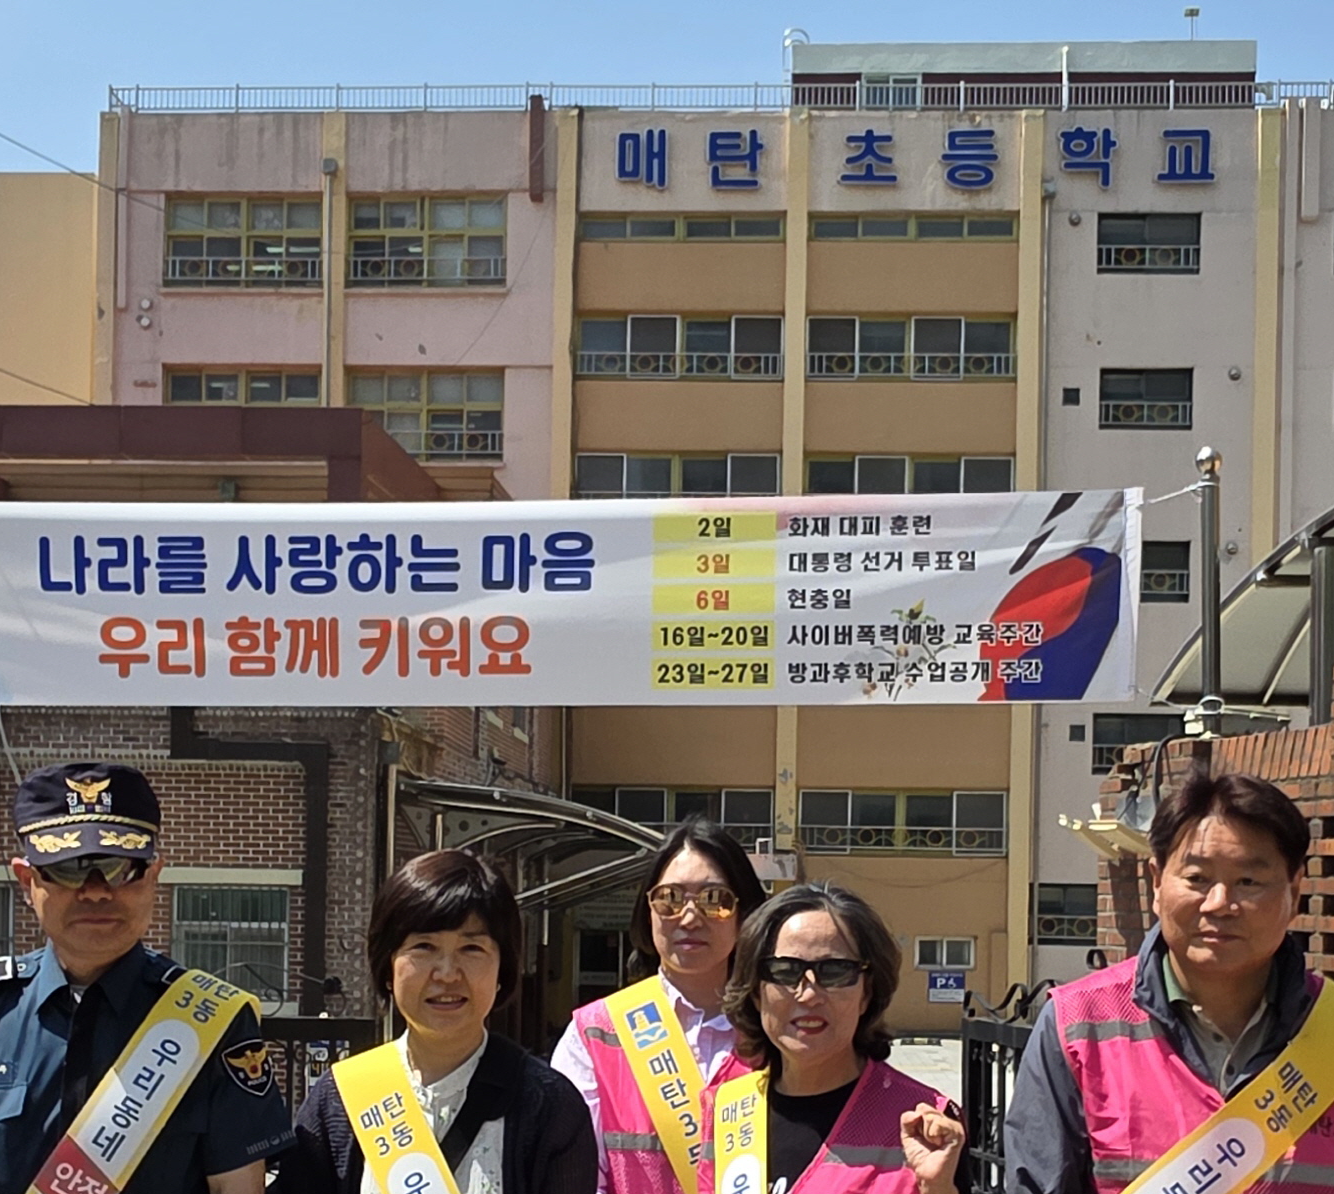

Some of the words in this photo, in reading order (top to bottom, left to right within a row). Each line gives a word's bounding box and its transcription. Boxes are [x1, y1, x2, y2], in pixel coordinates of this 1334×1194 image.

[697, 515, 732, 539] 2일
[787, 515, 832, 539] 화재
[837, 514, 882, 538] 대피
[888, 513, 932, 538] 훈련
[37, 534, 208, 596] 나라를
[226, 533, 462, 596] 사랑하는
[481, 532, 596, 594] 마음
[696, 551, 731, 575] 3일
[787, 550, 856, 575] 대통령
[860, 549, 906, 574] 선거
[909, 548, 977, 573] 투표일
[695, 588, 730, 612] 6일
[787, 586, 852, 611] 현충일
[98, 616, 205, 680] 우리
[225, 616, 340, 680] 함께
[358, 615, 533, 679] 키워요
[659, 623, 769, 648] 16일~20일
[787, 621, 948, 648] 사이버폭력예방
[952, 621, 1044, 647] 교육주간
[657, 659, 769, 686] 23일~27일
[787, 659, 898, 685] 방과후학교
[904, 659, 992, 685] 수업공개
[998, 659, 1043, 685] 주간
[191, 974, 241, 1002] 매탄
[175, 991, 218, 1025] 3동
[92, 1037, 183, 1164] 우리동네
[1278, 1061, 1320, 1113] 매탄
[360, 1092, 405, 1131] 매탄
[722, 1094, 757, 1123] 매탄
[1254, 1090, 1295, 1134] 3동
[374, 1123, 414, 1156] 3동
[725, 1121, 754, 1152] 3동
